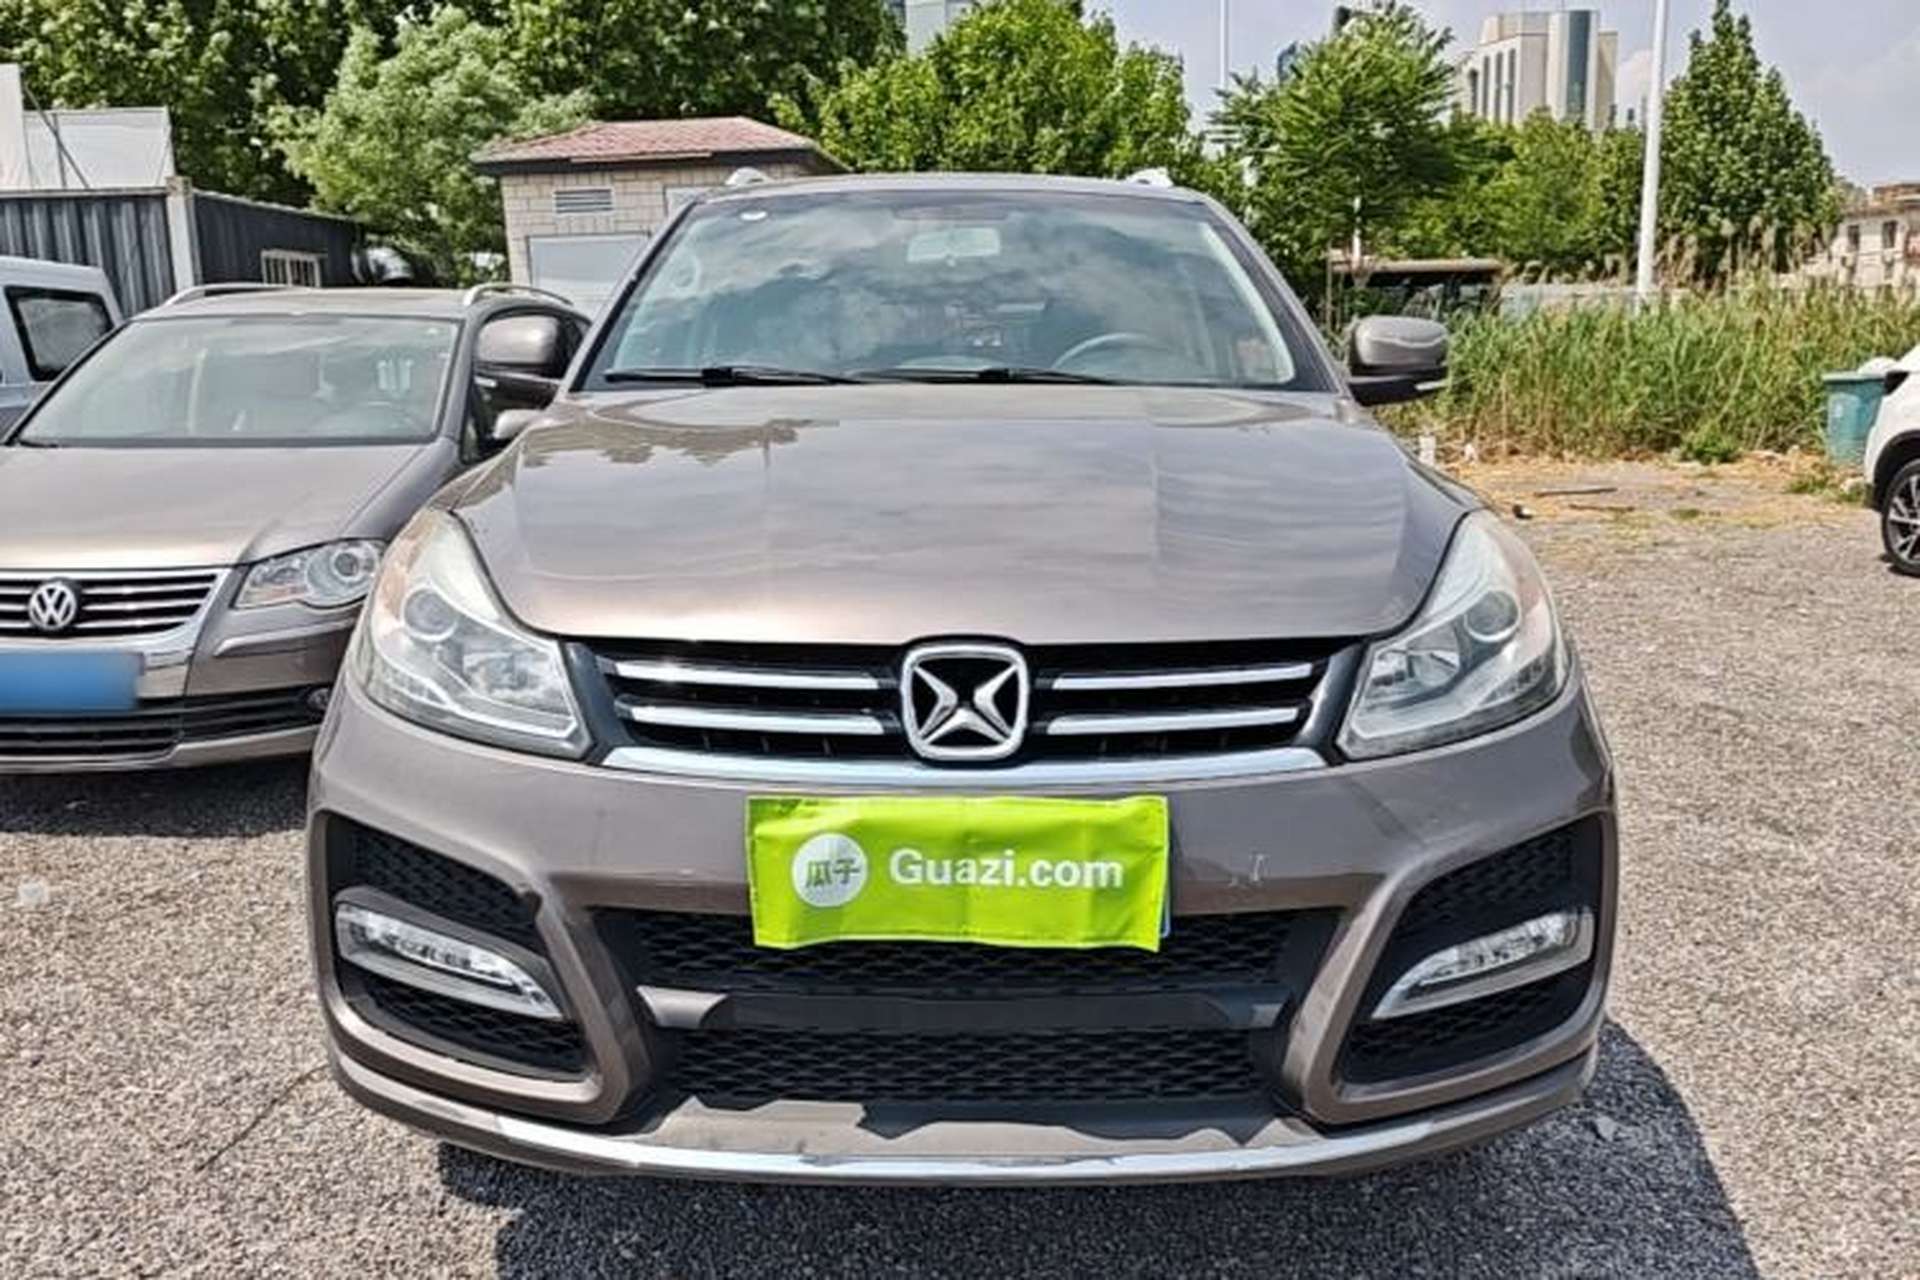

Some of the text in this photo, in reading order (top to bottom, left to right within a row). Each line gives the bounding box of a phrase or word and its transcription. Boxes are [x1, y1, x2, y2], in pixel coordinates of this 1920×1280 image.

[30, 583, 76, 629] VW
[805, 857, 861, 888] 瓜子
[889, 848, 1124, 888] Guazi.com
